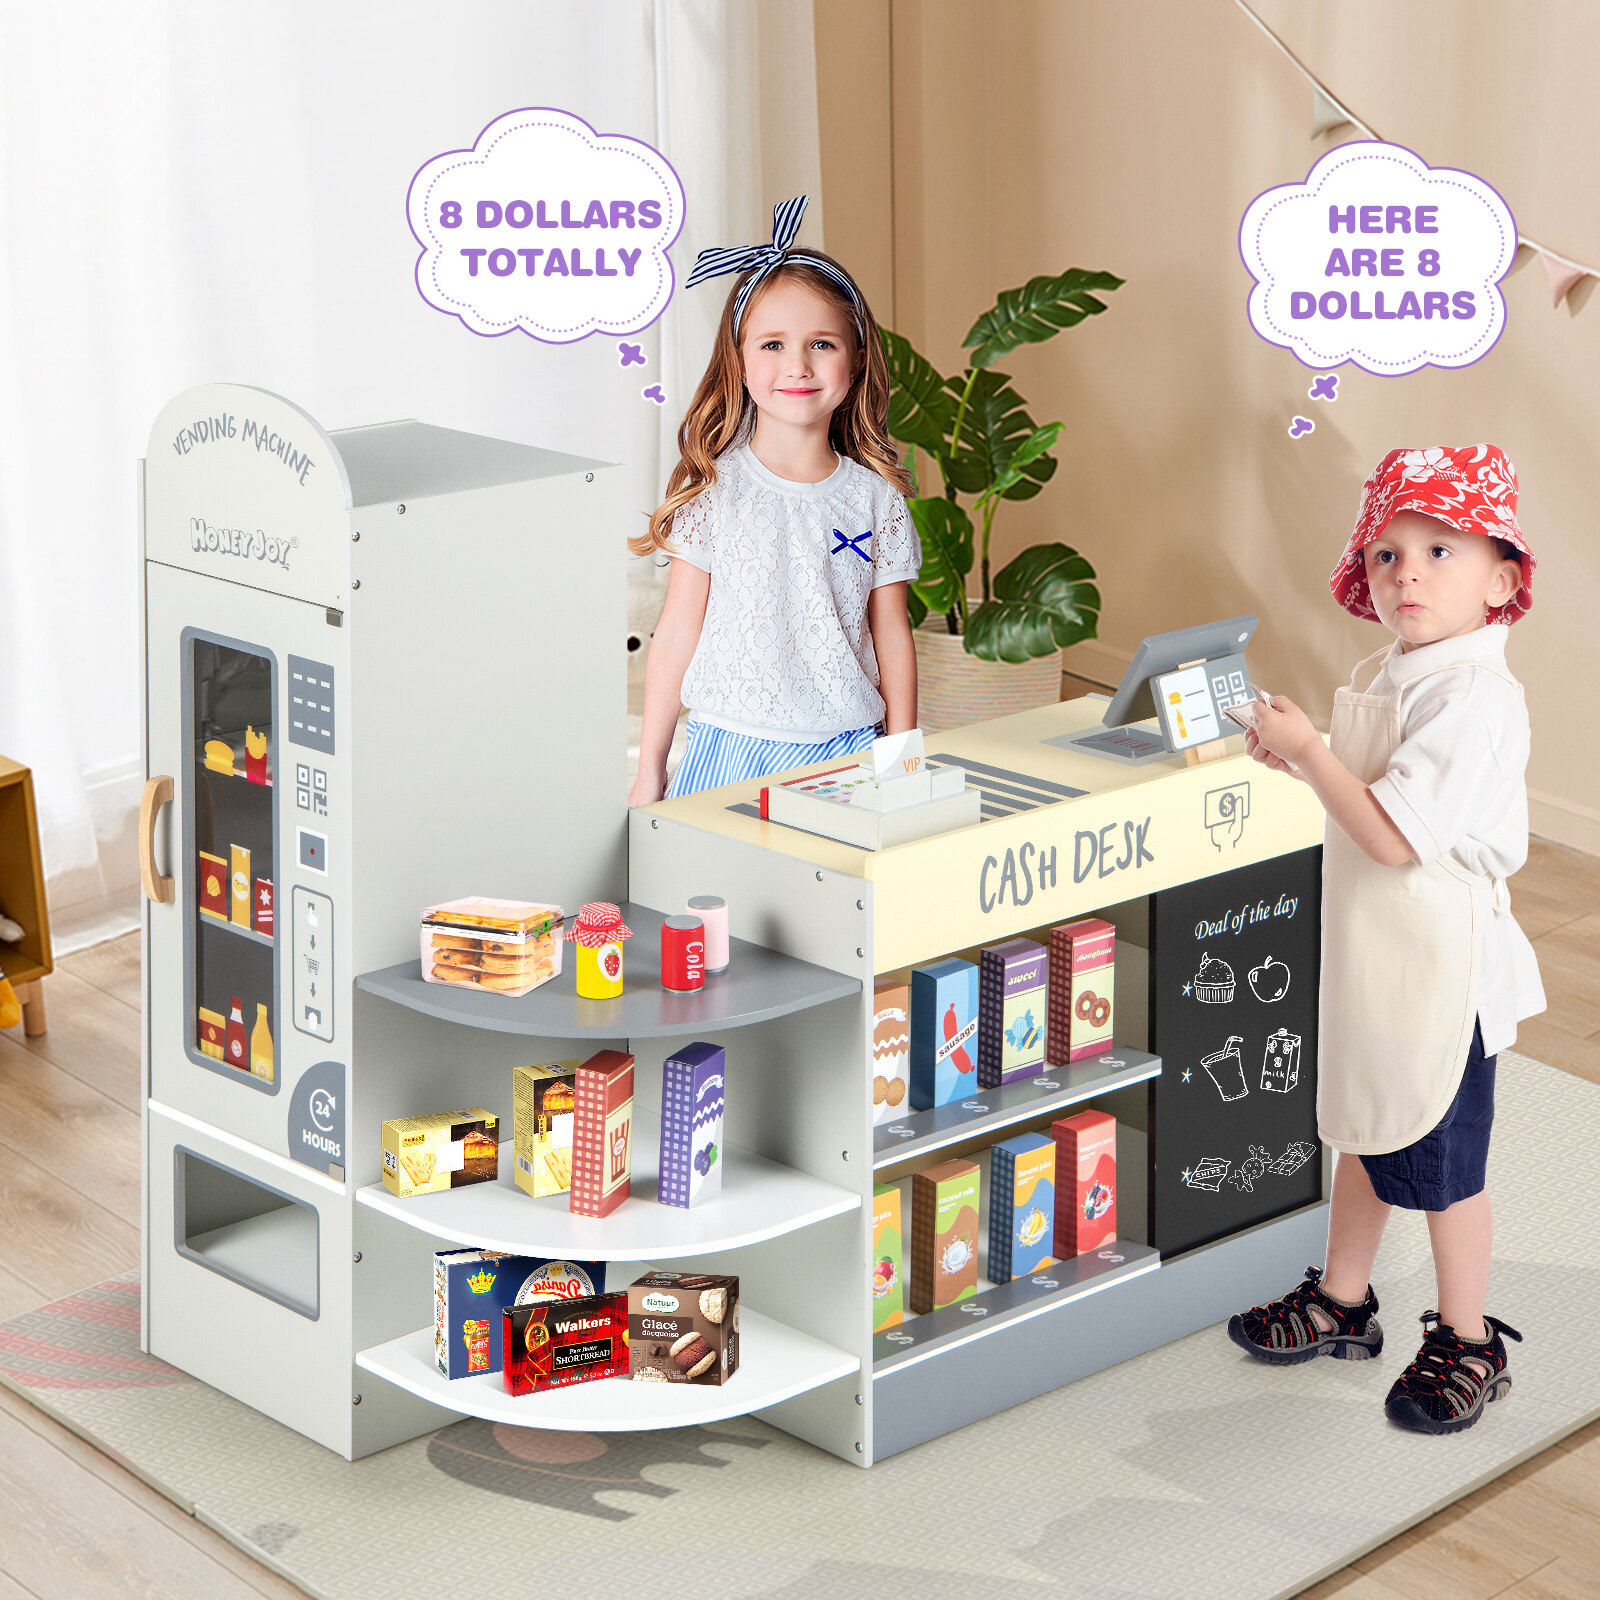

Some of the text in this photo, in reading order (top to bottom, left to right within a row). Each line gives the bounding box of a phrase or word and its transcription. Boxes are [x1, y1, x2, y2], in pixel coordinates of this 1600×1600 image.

[172, 412, 316, 487] VENDING MACHINE
[903, 756, 921, 773] VIP
[979, 816, 1154, 914] CASH DESK
[1194, 893, 1299, 940] Deal of the day
[685, 941, 704, 981] Cola
[938, 1022, 976, 1058] sausage
[1263, 1069, 1285, 1079] milk
[315, 1101, 331, 1118] 24
[302, 1128, 341, 1158] HOURS
[1195, 1168, 1221, 1179] CHIPS
[646, 1298, 675, 1308] Natuur
[555, 1317, 612, 1335] Walkers
[641, 1318, 678, 1331] Glacé
[555, 1349, 611, 1366] SHORTBREAD
